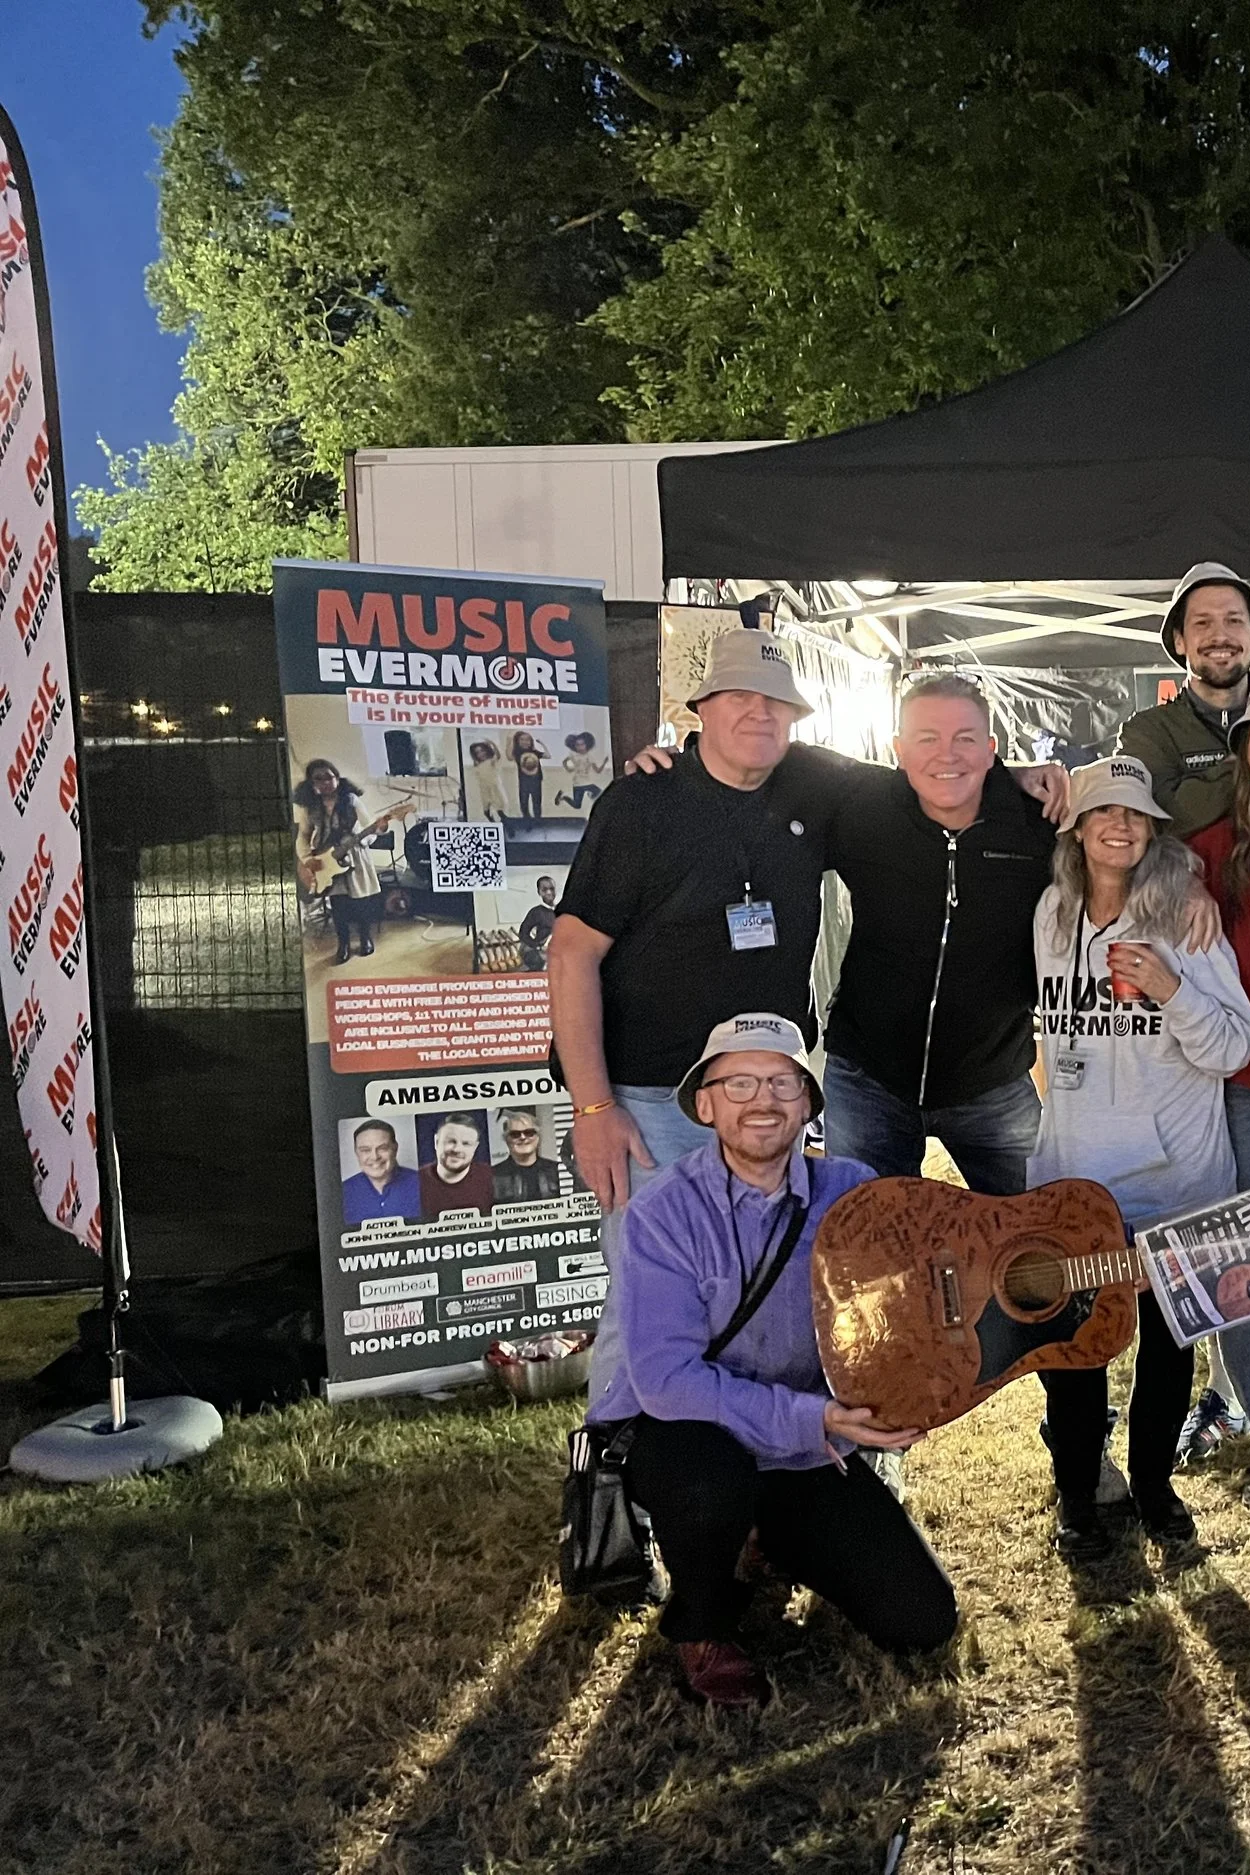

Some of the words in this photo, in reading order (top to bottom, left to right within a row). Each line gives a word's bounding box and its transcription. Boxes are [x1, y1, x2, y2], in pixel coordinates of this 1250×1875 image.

[15, 520, 58, 640] MUSI
[316, 589, 575, 657] MUSIC
[317, 647, 578, 693] EVERMORE
[348, 689, 390, 705] The
[393, 690, 465, 708] future
[468, 693, 493, 708] of
[496, 695, 558, 710] music
[367, 707, 385, 722] is
[389, 708, 411, 722] in
[416, 710, 465, 726] your
[469, 711, 543, 726] hands!
[7, 662, 59, 798] MUSIC
[14, 691, 65, 817] EVERMORE
[8, 833, 51, 957] MUSIC
[382, 997, 412, 1008] WITH
[413, 997, 442, 1007] FREE
[444, 995, 468, 1006] AND
[1042, 976, 1163, 1012] MUS
[10, 980, 39, 1061] USIC
[478, 1006, 502, 1017] AND
[503, 1004, 550, 1015] HOLIDAY
[344, 1027, 369, 1038] ARE
[431, 1023, 448, 1034] TO
[336, 1041, 376, 1053] LOCAL
[451, 1034, 498, 1046] GRANTS
[498, 1032, 521, 1043] AND
[522, 1031, 546, 1041] THE
[417, 1051, 442, 1062] THE
[443, 1048, 480, 1059] LOCAL
[443, 1212, 474, 1221] ACTOR
[496, 1201, 564, 1215] ENTREPRENEUR
[531, 1213, 559, 1223] YATES
[366, 1220, 398, 1230] ACTOR
[427, 1223, 467, 1235] ANDREW
[466, 1264, 523, 1287] enamill
[464, 1293, 516, 1307] MANCHESTER
[538, 1284, 599, 1306] RISING
[350, 1329, 441, 1355] NON-FOR
[446, 1318, 514, 1341] PROFIT
[519, 1312, 557, 1329] CIC:
[562, 1304, 604, 1324] 1580
[374, 1309, 424, 1330] LIBRARY
